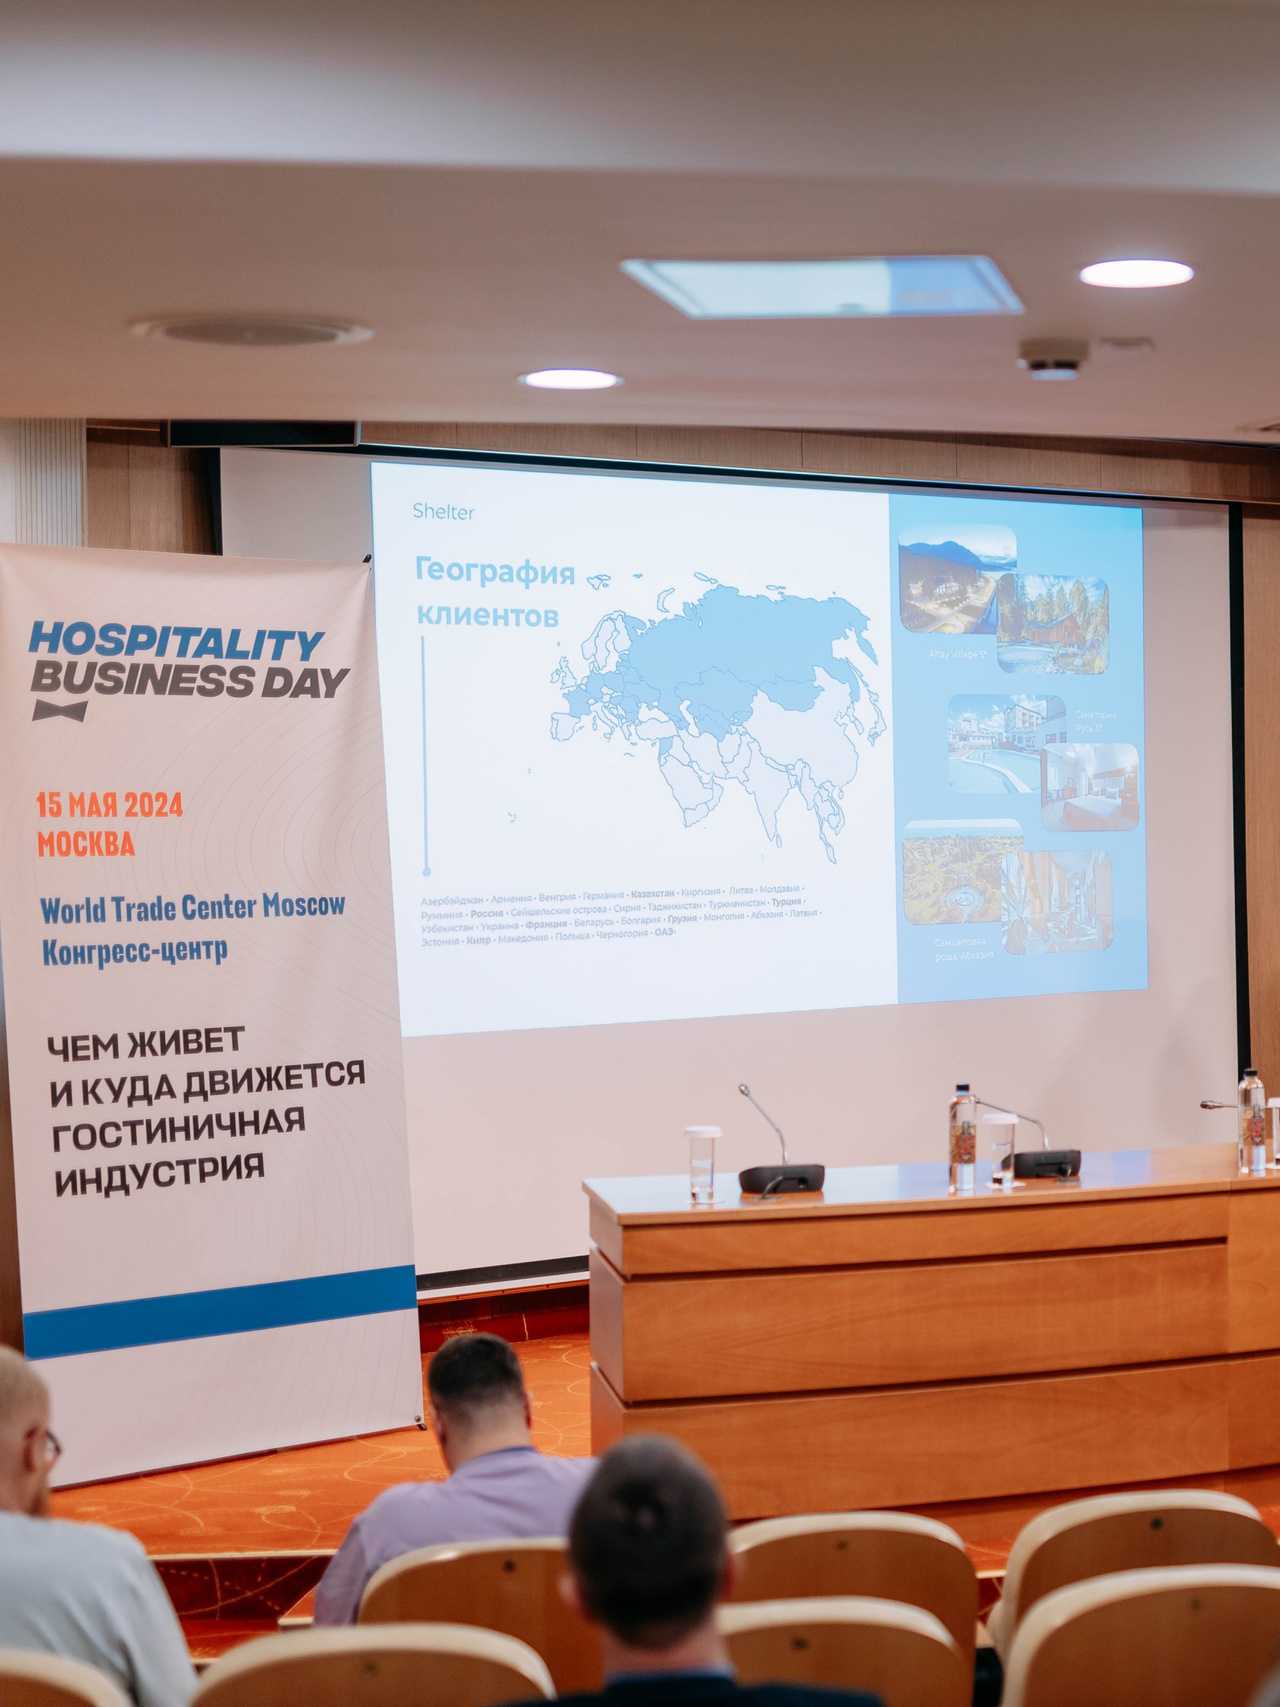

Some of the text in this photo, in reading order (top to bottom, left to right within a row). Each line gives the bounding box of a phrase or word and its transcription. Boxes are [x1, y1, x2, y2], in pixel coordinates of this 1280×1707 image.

[412, 502, 476, 521] Shelter
[415, 555, 576, 590] География
[417, 605, 560, 628] клиентов
[28, 620, 326, 662] HOSPITALITY
[30, 660, 352, 699] BUSINESS DAY
[36, 791, 184, 818] 15 МАЯ 2024
[37, 830, 136, 858] МОСКВА
[40, 891, 346, 925] World Trade Center Moscow
[420, 884, 801, 907] Азербайджан Армения Венгрия Германия Казахстан Киргизия Литва Молдавия
[420, 897, 803, 921] Румыния Россия Сейшельские острова Сирия Таджикистан Туркменистан Турция
[420, 908, 818, 934] Узбекистан Украина Франция Беларусь Болгария Грузия Монголия Абхазия Латвия
[420, 937, 460, 947] Эстония
[466, 935, 492, 946] Кипр
[498, 934, 549, 944] Македония
[555, 931, 591, 942] Польша
[596, 928, 649, 940] Черногория
[42, 937, 228, 970] Конгресс-центр
[960, 950, 994, 960] Абхазия
[47, 1025, 246, 1063] ЧЕМ ЖИВЕТ
[50, 1059, 366, 1108] И КУДА ДВИЖЕТСЯ
[52, 1105, 306, 1153] ГОСТИНИЧНАЯ
[55, 1152, 266, 1199] ИНДУСТРИЯ
